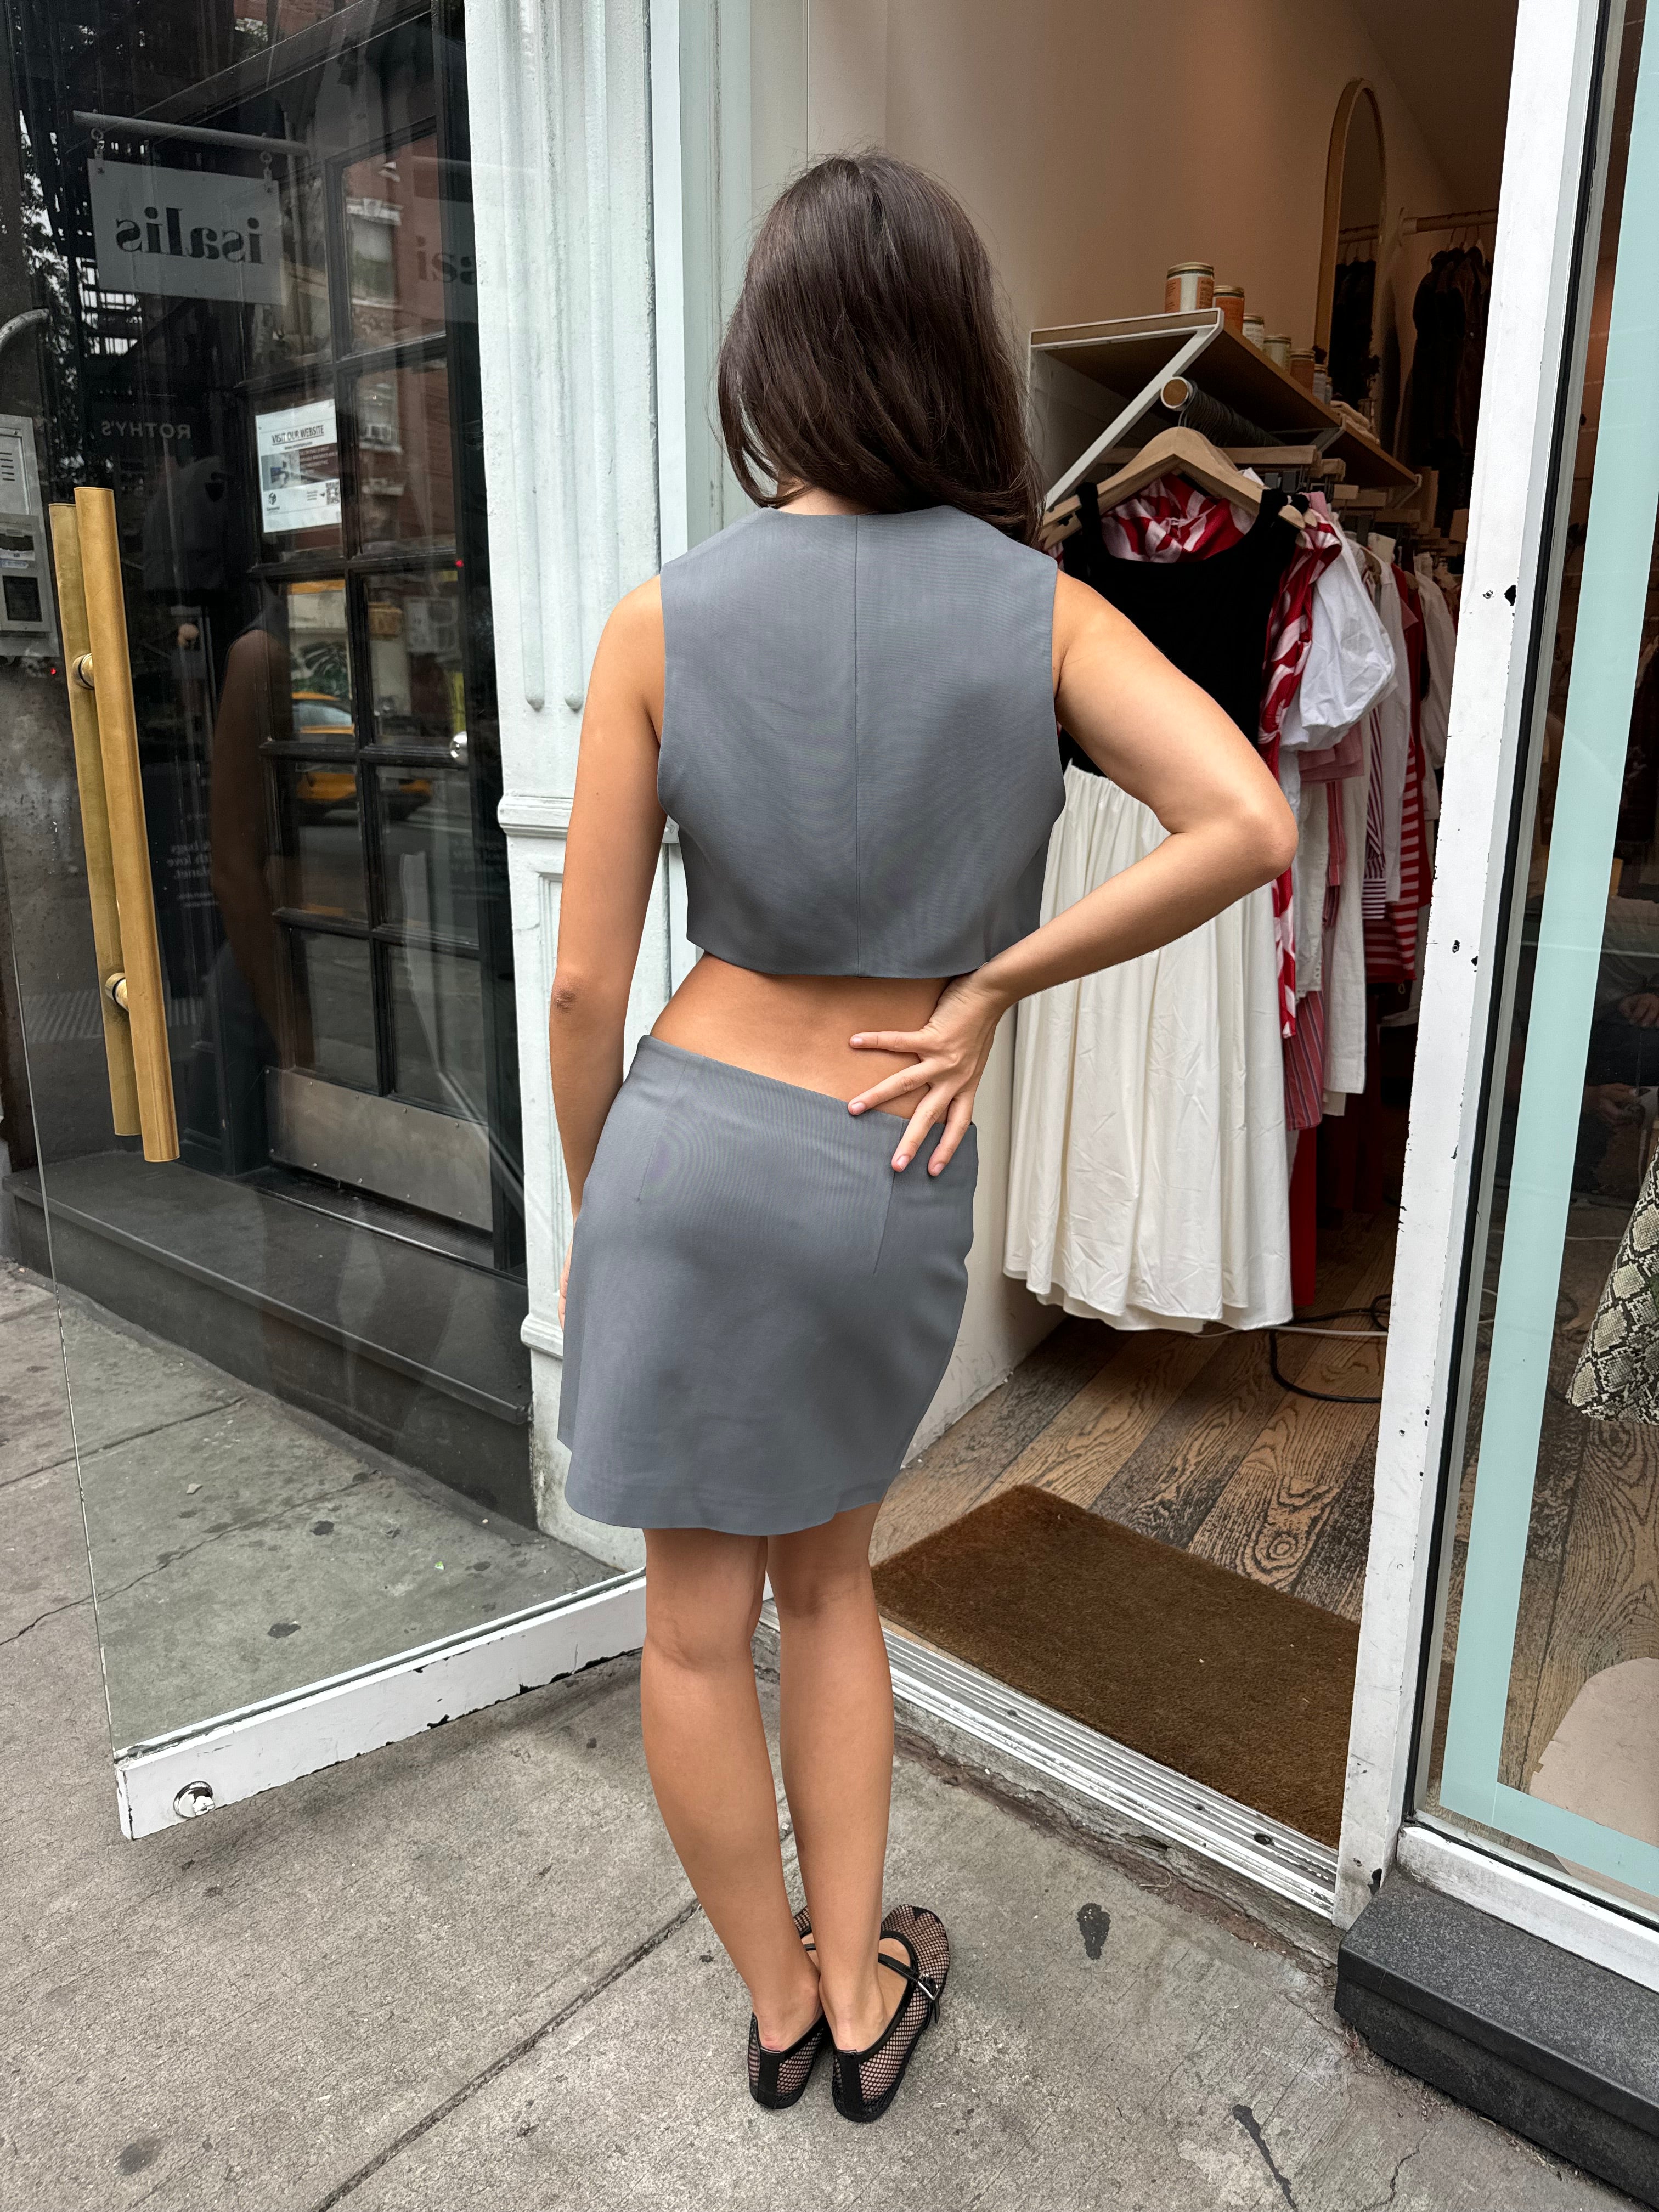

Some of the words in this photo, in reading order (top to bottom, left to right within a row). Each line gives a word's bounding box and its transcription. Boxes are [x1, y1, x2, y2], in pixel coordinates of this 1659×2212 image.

[272, 432, 285, 443] VISIT
[287, 430, 299, 441] OUR
[300, 425, 324, 438] WEBSITE
